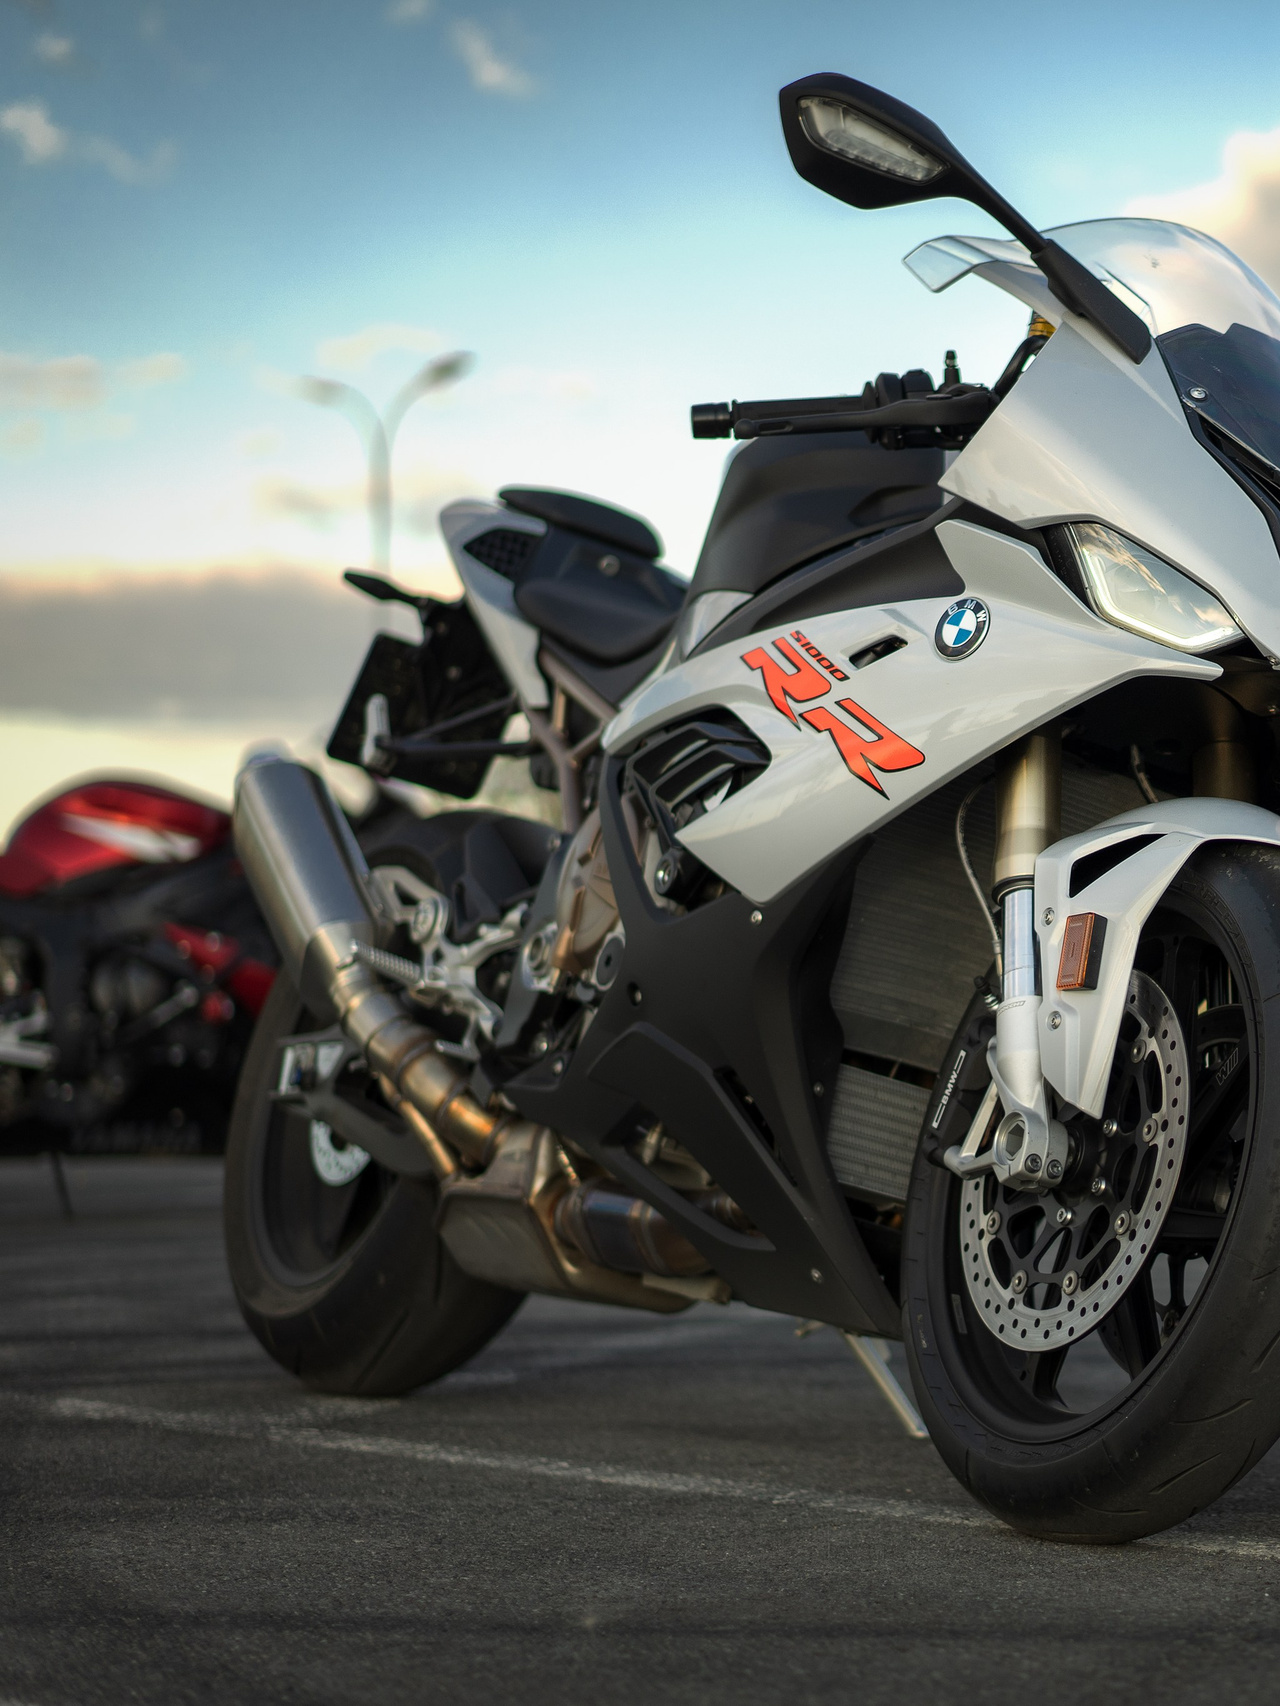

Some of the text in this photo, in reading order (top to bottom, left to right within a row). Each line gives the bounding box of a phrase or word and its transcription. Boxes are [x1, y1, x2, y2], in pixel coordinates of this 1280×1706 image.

[947, 599, 987, 622] BMW
[790, 630, 850, 681] S1000
[740, 636, 925, 800] RR
[941, 1070, 958, 1105] BMW
